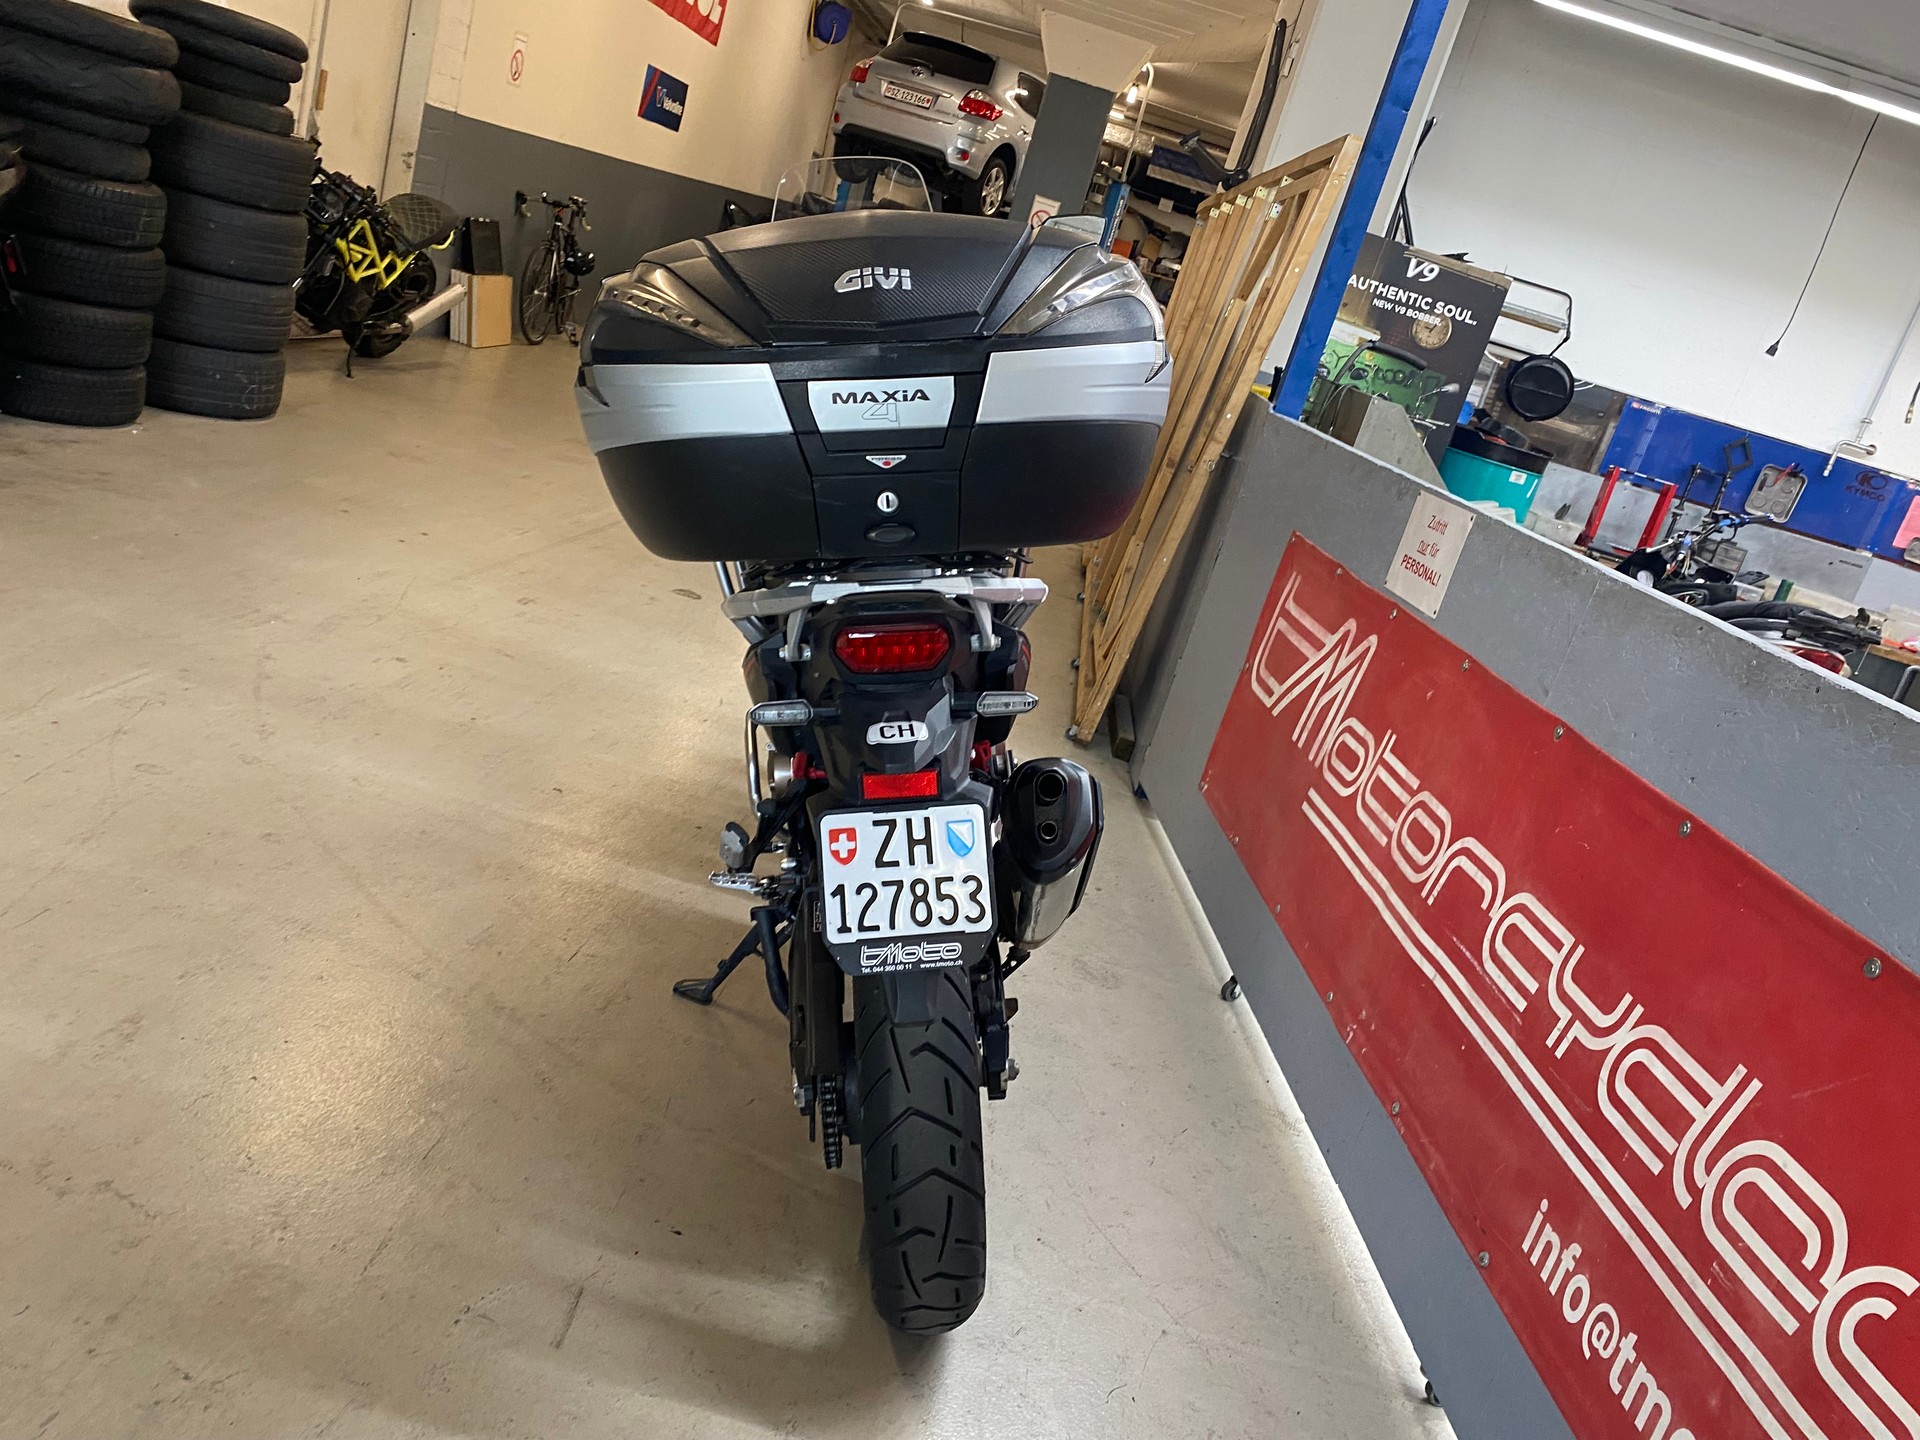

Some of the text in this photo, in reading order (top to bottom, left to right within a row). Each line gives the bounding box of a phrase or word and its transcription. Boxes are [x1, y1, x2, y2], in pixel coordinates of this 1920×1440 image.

[901, 91, 926, 104] 123166
[834, 266, 912, 293] GIVI
[1405, 256, 1440, 282] V9
[1347, 274, 1478, 326] AUTHENTIC SOUL.
[1372, 298, 1442, 326] NEW V9 BOBBER.
[861, 402, 898, 423] 4
[1427, 515, 1448, 535] Zutritt
[1417, 540, 1440, 558] nur für
[1400, 554, 1441, 587] PERSONAL!
[879, 723, 916, 740] CH
[872, 816, 934, 868] ZH
[830, 875, 986, 934] 127853
[872, 965, 884, 973] 044
[896, 963, 905, 971] 00
[920, 960, 963, 969] www.tmoto.ch
[1521, 1199, 1696, 1440] info@tm
